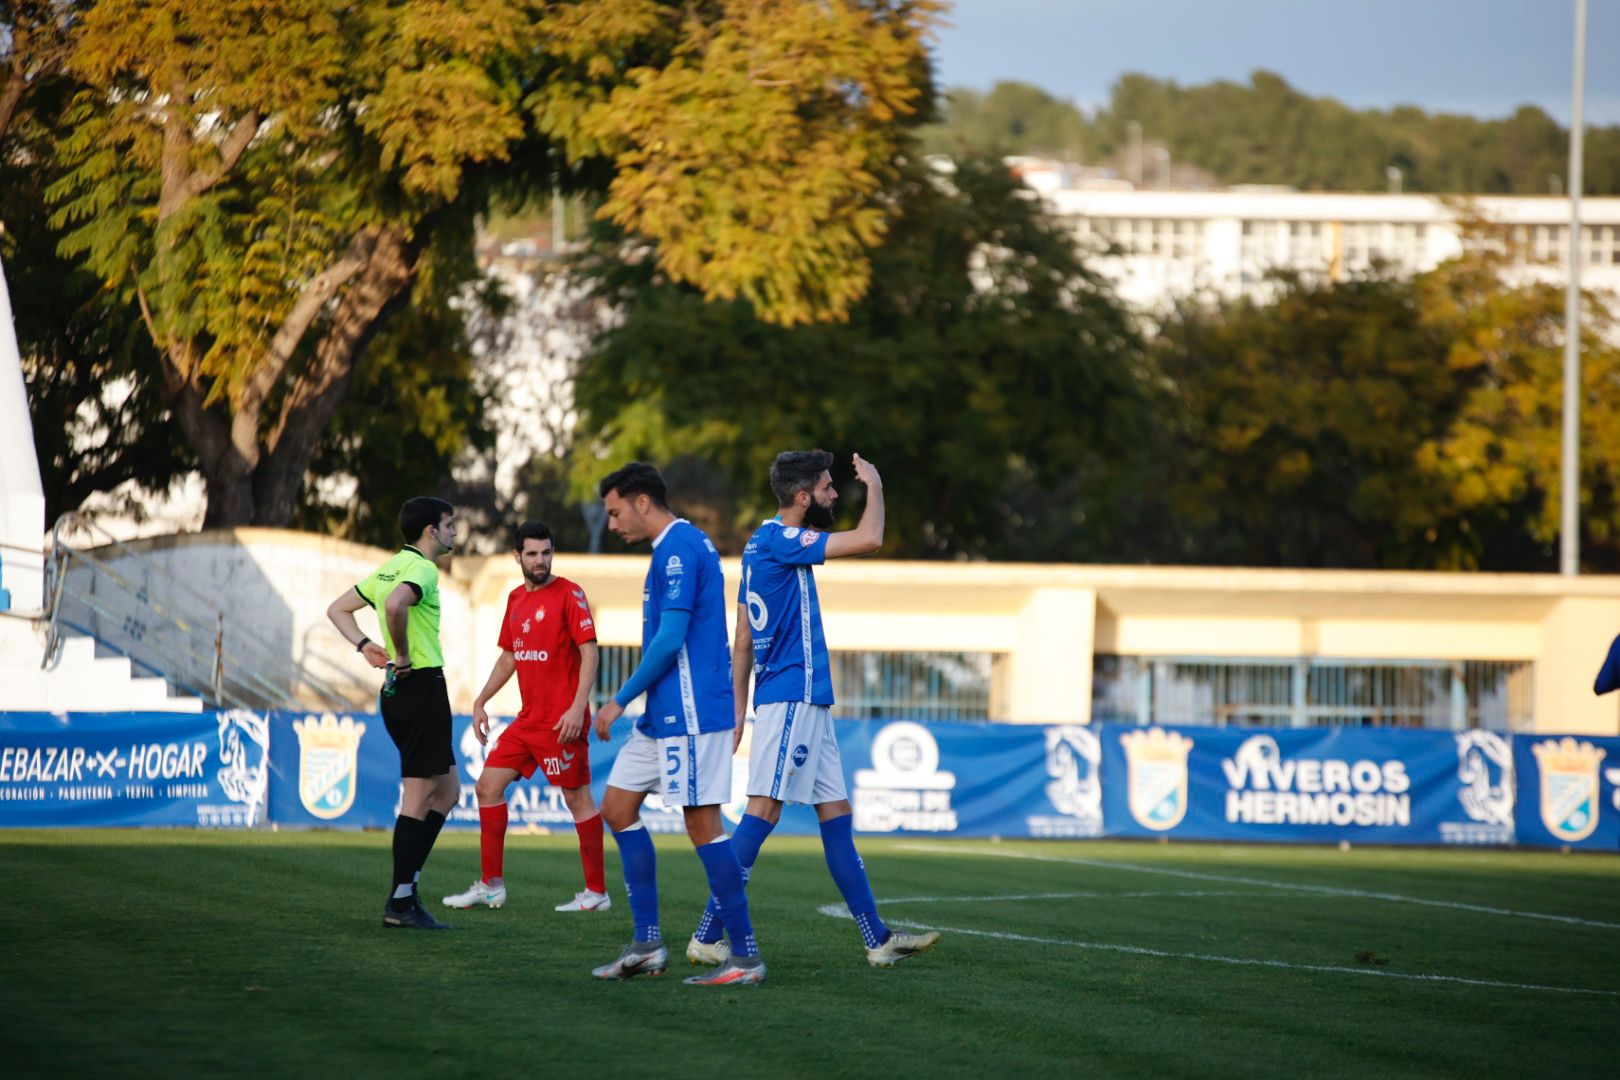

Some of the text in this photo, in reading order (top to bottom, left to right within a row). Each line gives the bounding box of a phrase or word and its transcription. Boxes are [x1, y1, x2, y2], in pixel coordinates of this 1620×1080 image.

[543, 757, 560, 776] 20
[666, 746, 681, 775] 5
[1222, 757, 1410, 793] VIVEROS
[1226, 789, 1411, 826] HERMOSIN
